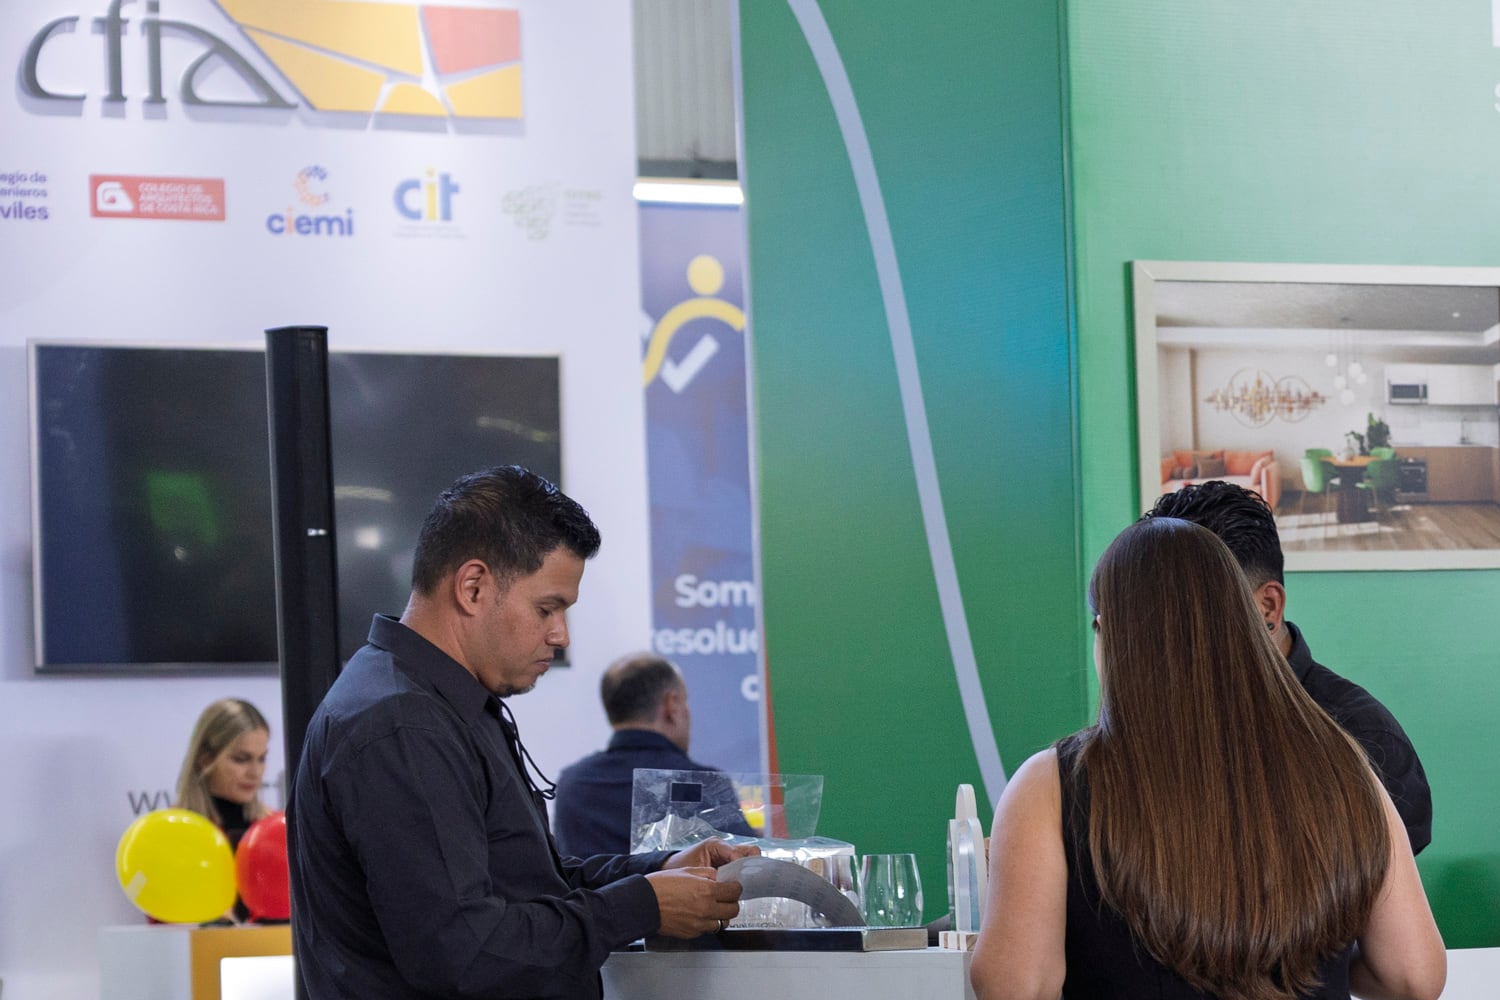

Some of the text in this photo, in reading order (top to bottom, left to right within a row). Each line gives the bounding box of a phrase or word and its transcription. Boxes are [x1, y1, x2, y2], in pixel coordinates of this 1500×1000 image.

[393, 167, 460, 222] cit
[266, 204, 354, 236] ciemi
[653, 619, 758, 655] esolu
